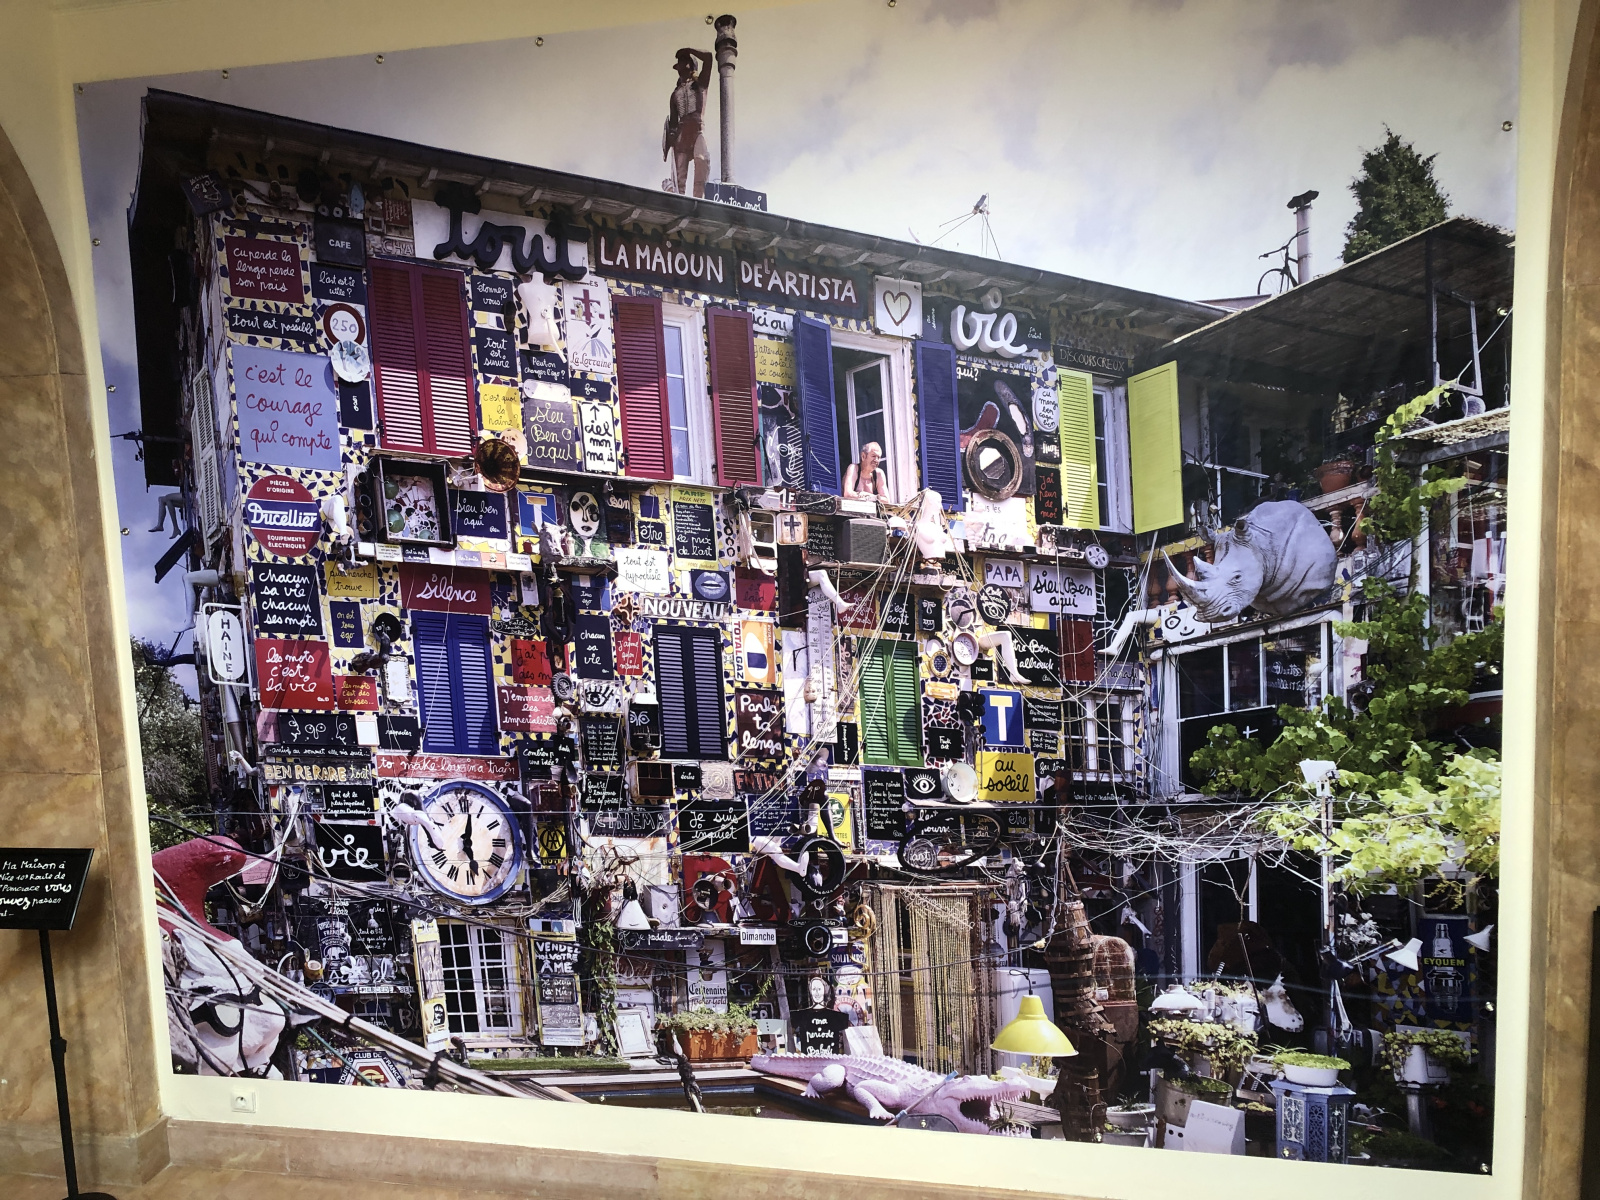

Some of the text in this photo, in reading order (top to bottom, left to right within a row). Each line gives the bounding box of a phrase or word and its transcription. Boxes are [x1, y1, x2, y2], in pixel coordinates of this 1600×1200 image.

[329, 239, 351, 249] CAFE
[282, 250, 292, 263] la
[600, 236, 629, 268] LA
[236, 262, 295, 280] lenga perde
[236, 277, 255, 287] son
[232, 312, 314, 336] tout est possible
[332, 318, 357, 333] 250
[951, 287, 1027, 359] vie
[484, 337, 507, 350] tout
[490, 350, 501, 358] est
[571, 352, 611, 368] La Lorraine
[246, 364, 312, 388] c'est le
[501, 392, 517, 404] quoi
[246, 394, 322, 427] courage
[497, 405, 505, 414] la
[489, 414, 512, 426] haine
[531, 424, 559, 442] Ben
[585, 420, 612, 437] ciel
[251, 421, 332, 455] qui compte
[590, 438, 611, 448] mon
[678, 489, 706, 497] TARIF
[1039, 490, 1057, 500] peur
[481, 501, 498, 515] ben
[1045, 500, 1053, 508] de
[248, 503, 317, 527] Ducellier
[1041, 510, 1058, 518] moi
[640, 526, 662, 540] être
[268, 541, 306, 549] ÉLECTRIQUES
[678, 547, 690, 556] de
[624, 556, 656, 566] tout est
[259, 569, 310, 584] chacun
[986, 565, 1021, 582] PAPA
[260, 584, 306, 597] sa vie
[416, 574, 477, 602] silence
[1064, 577, 1092, 596] Ben
[262, 600, 311, 612] chacun
[644, 599, 724, 619] NOUVEAU
[264, 614, 317, 627] ses mots
[340, 632, 355, 643] ego
[581, 630, 605, 640] chacun
[221, 619, 232, 673] HAINE
[733, 621, 744, 679] TOTALGAZ
[1029, 639, 1050, 653] Ben
[266, 647, 314, 663] les mots
[584, 653, 602, 665] vie
[271, 664, 304, 678] c'est
[519, 670, 534, 679] des
[266, 676, 316, 692] la vie
[353, 682, 370, 690] mots
[502, 690, 555, 703] J'emmerde
[740, 695, 778, 714] Parla
[752, 714, 771, 731] ta
[742, 730, 782, 755] lenga
[264, 764, 370, 780] BEN tout
[378, 758, 394, 769] to
[400, 759, 437, 772] make
[488, 760, 515, 775] train
[995, 760, 1016, 772] au
[984, 774, 1029, 793] soleil
[690, 811, 705, 828] Je
[713, 807, 739, 823] suis
[319, 834, 378, 869] vie
[3, 861, 17, 870] Ma
[21, 858, 56, 869] Maison
[30, 872, 53, 880] Route
[45, 884, 71, 893] vous
[32, 898, 61, 907] passer
[742, 932, 775, 941] Dimanche
[541, 960, 574, 973] ÂME
[1424, 958, 1465, 966] EYQUEM
